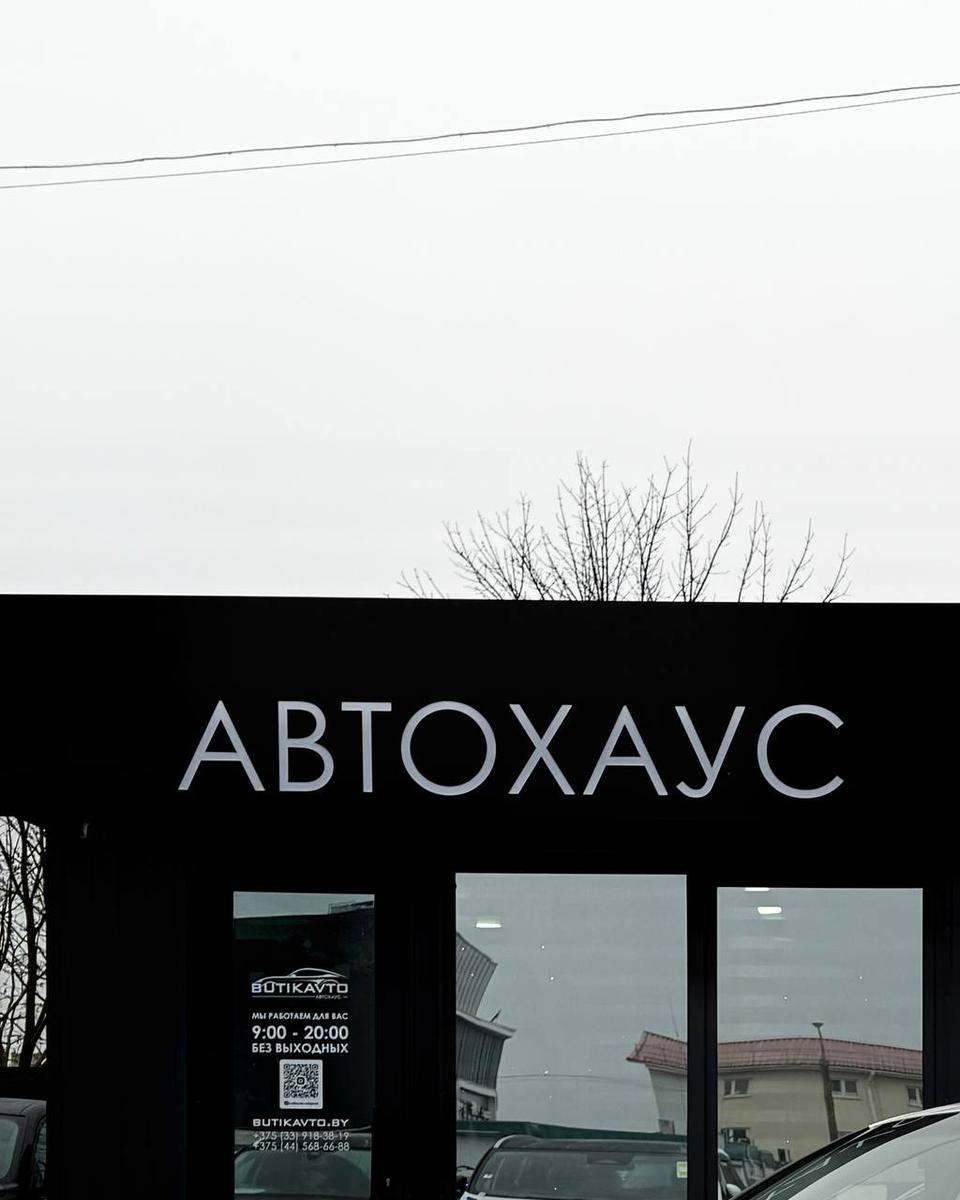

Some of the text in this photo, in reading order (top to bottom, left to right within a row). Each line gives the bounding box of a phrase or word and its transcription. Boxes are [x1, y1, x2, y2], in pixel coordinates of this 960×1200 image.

[178, 699, 846, 799] АВТОХАУС
[251, 982, 349, 994] BUTIKAVTO
[251, 1012, 349, 1021] МЫ РАБОТАЕМ ДЛЯ ВАС
[251, 1025, 287, 1040] 9:00
[303, 1025, 349, 1040] 20:00
[251, 1043, 349, 1054] БЕЗ ВЫХОДНЫХ
[252, 1118, 350, 1127] BUTIKAVTO.BY
[253, 1131, 350, 1142] +375 (33) 918-38-19
[253, 1142, 350, 1152] +375 (44) 568-66-88
